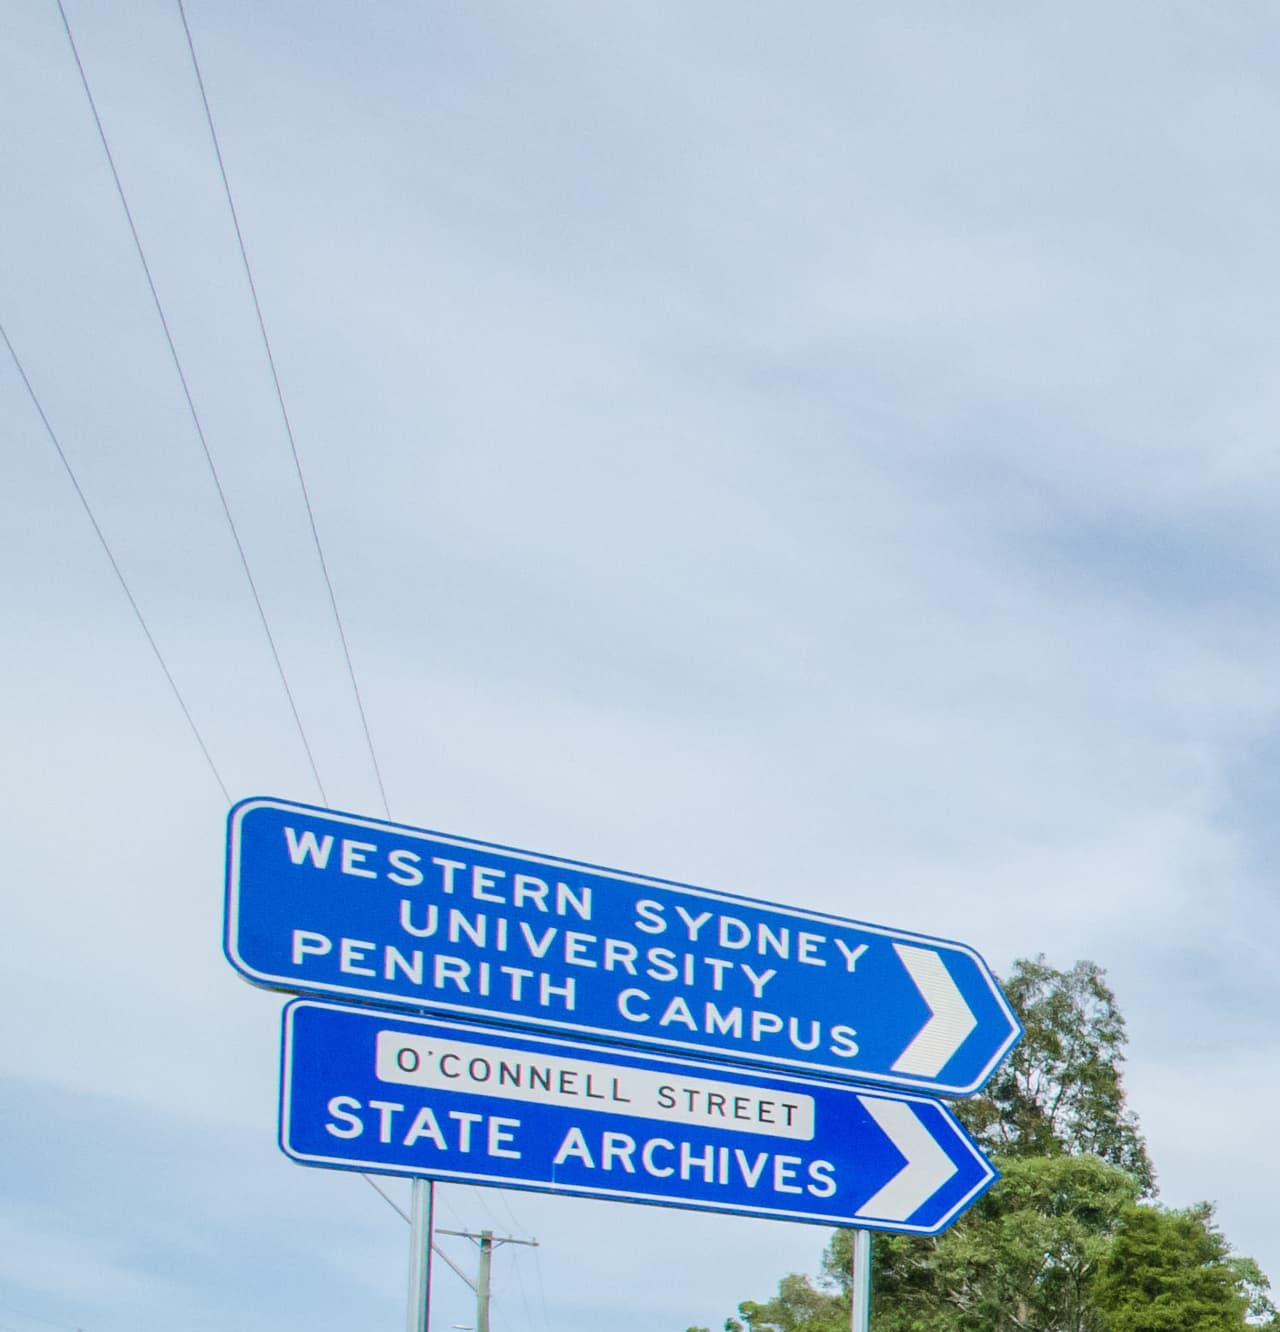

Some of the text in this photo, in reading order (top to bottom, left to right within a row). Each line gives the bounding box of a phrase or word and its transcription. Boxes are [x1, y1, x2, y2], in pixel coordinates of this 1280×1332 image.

[283, 826, 869, 974] WESTERN SYDNEY
[400, 898, 777, 999] UNIVERSITY
[291, 929, 860, 1059] PENRITH CAMPUS
[396, 1046, 800, 1128] O'CONNELL STREET
[324, 1094, 838, 1198] STATE ARCHIVES
